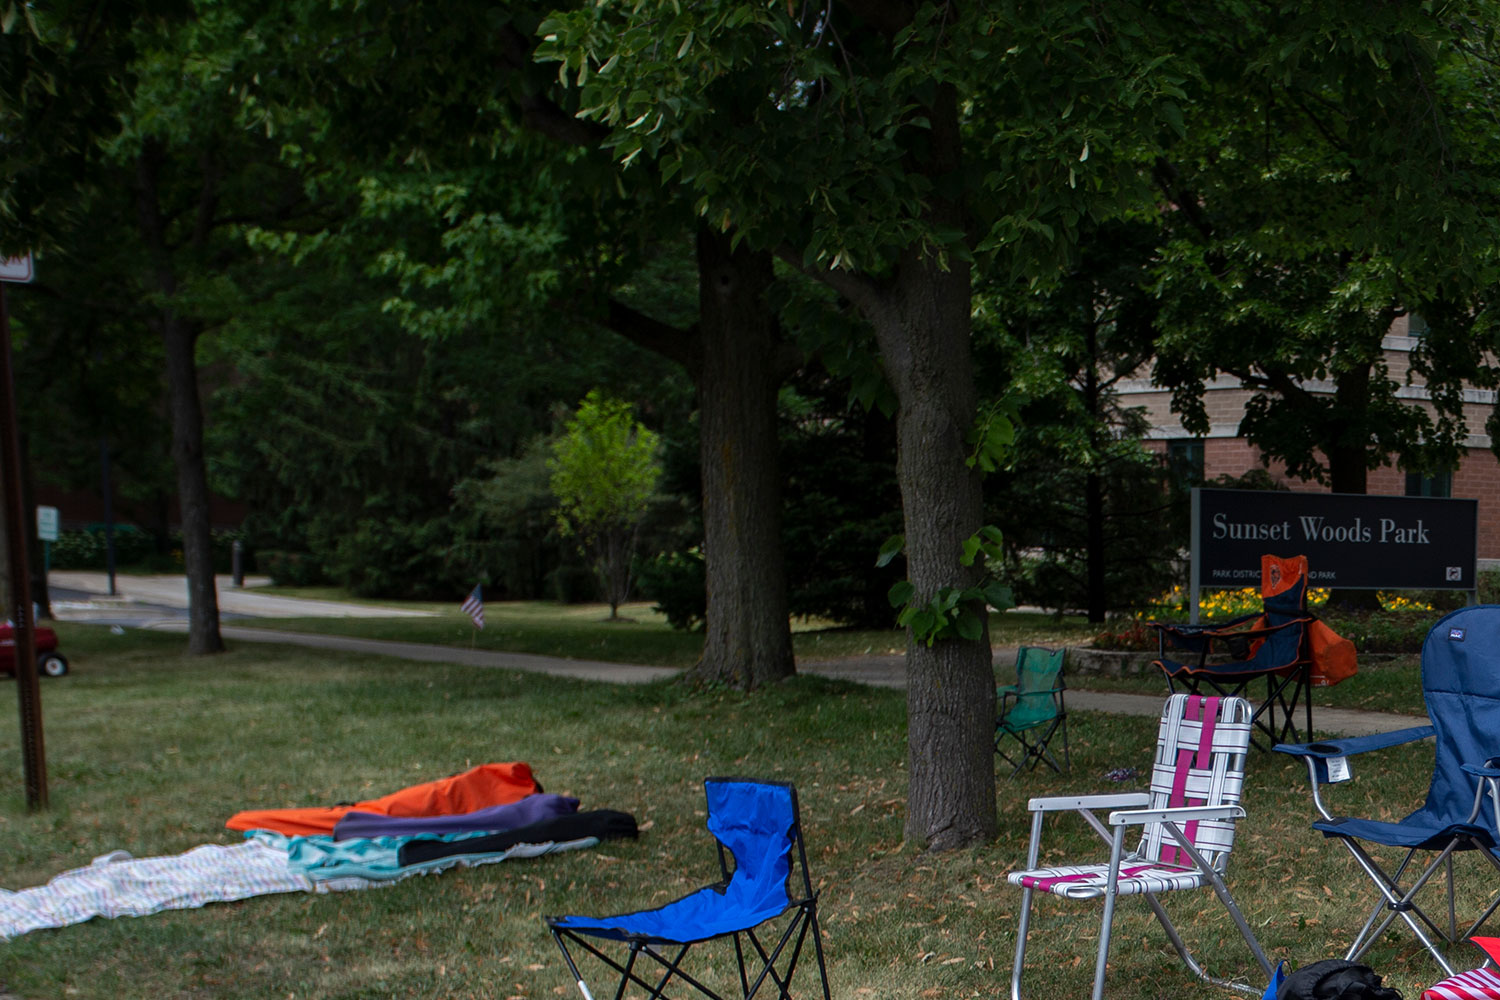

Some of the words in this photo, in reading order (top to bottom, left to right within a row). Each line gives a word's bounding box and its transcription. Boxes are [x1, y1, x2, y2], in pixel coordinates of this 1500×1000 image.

[1212, 512, 1291, 540] Sunset
[1299, 515, 1372, 543] Woods
[1378, 518, 1430, 544] Park
[1212, 569, 1231, 578] PARK
[1233, 569, 1262, 579] DISTRIC
[1318, 571, 1336, 579] PARK
